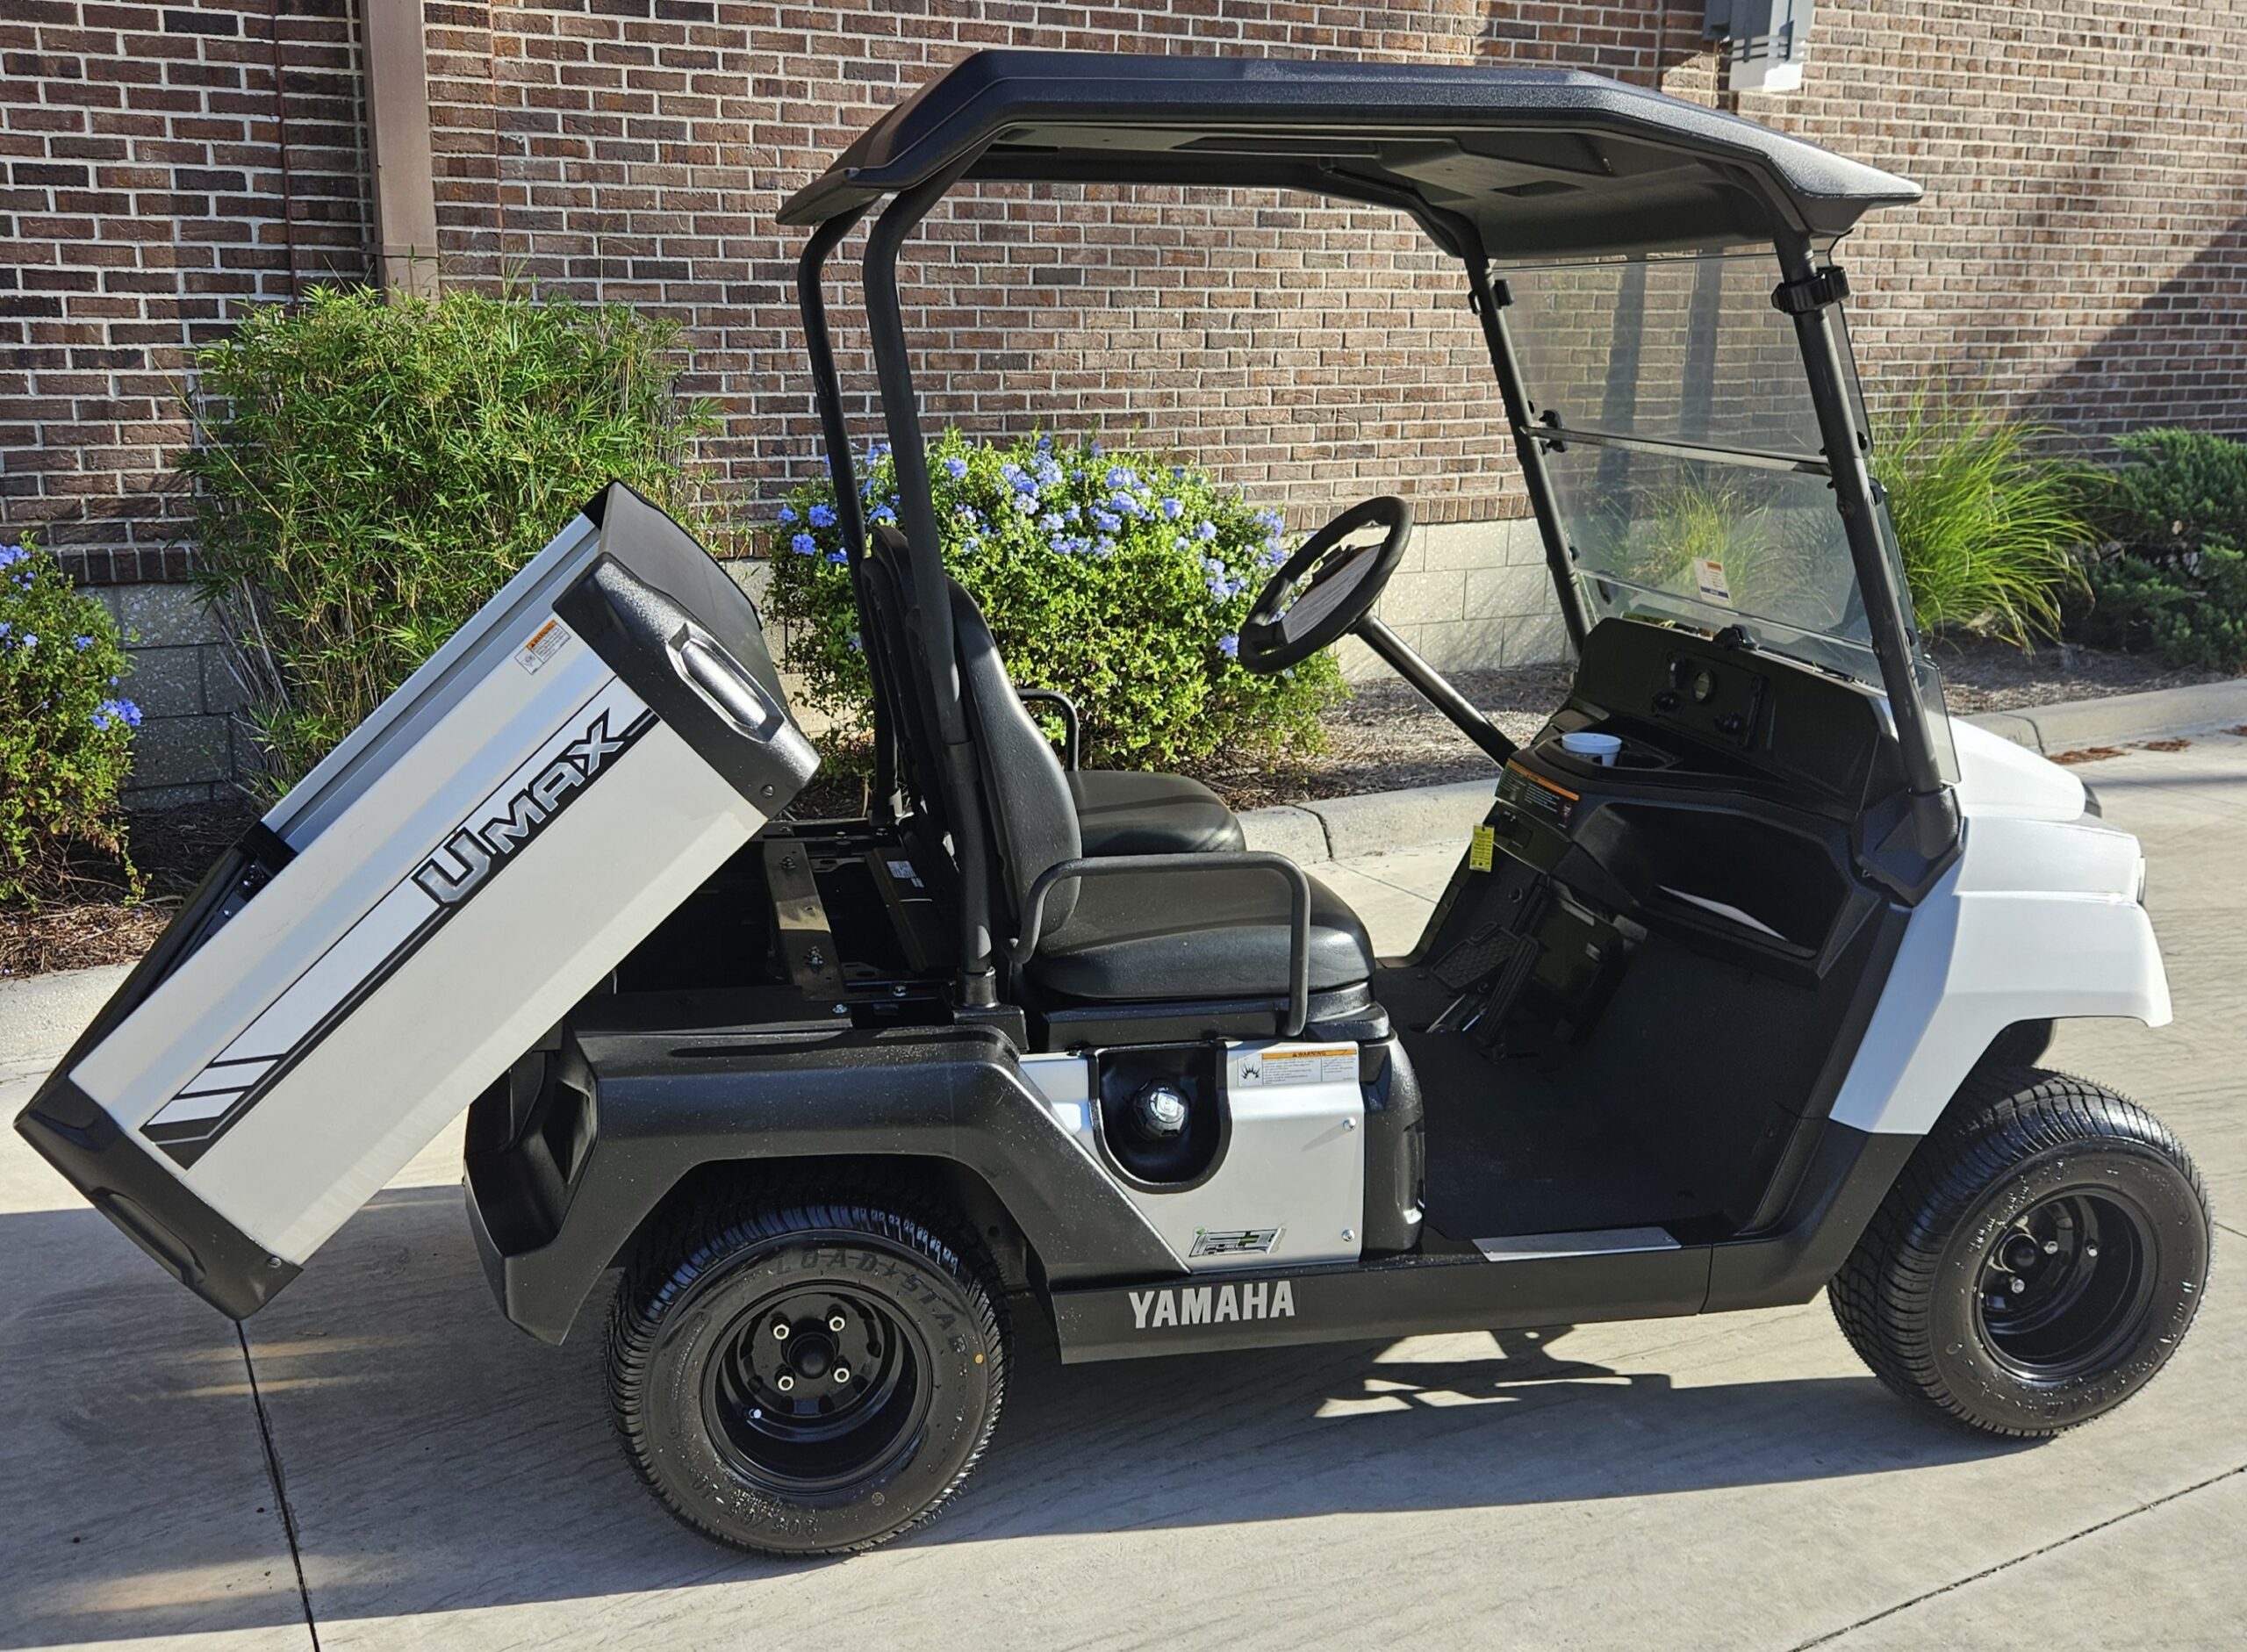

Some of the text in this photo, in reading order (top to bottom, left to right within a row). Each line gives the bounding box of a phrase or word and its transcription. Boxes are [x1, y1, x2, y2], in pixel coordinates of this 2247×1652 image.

[414, 715, 624, 904] UMAX
[775, 1249, 879, 1275] LOAD
[1129, 1281, 1295, 1328] YAMAHA
